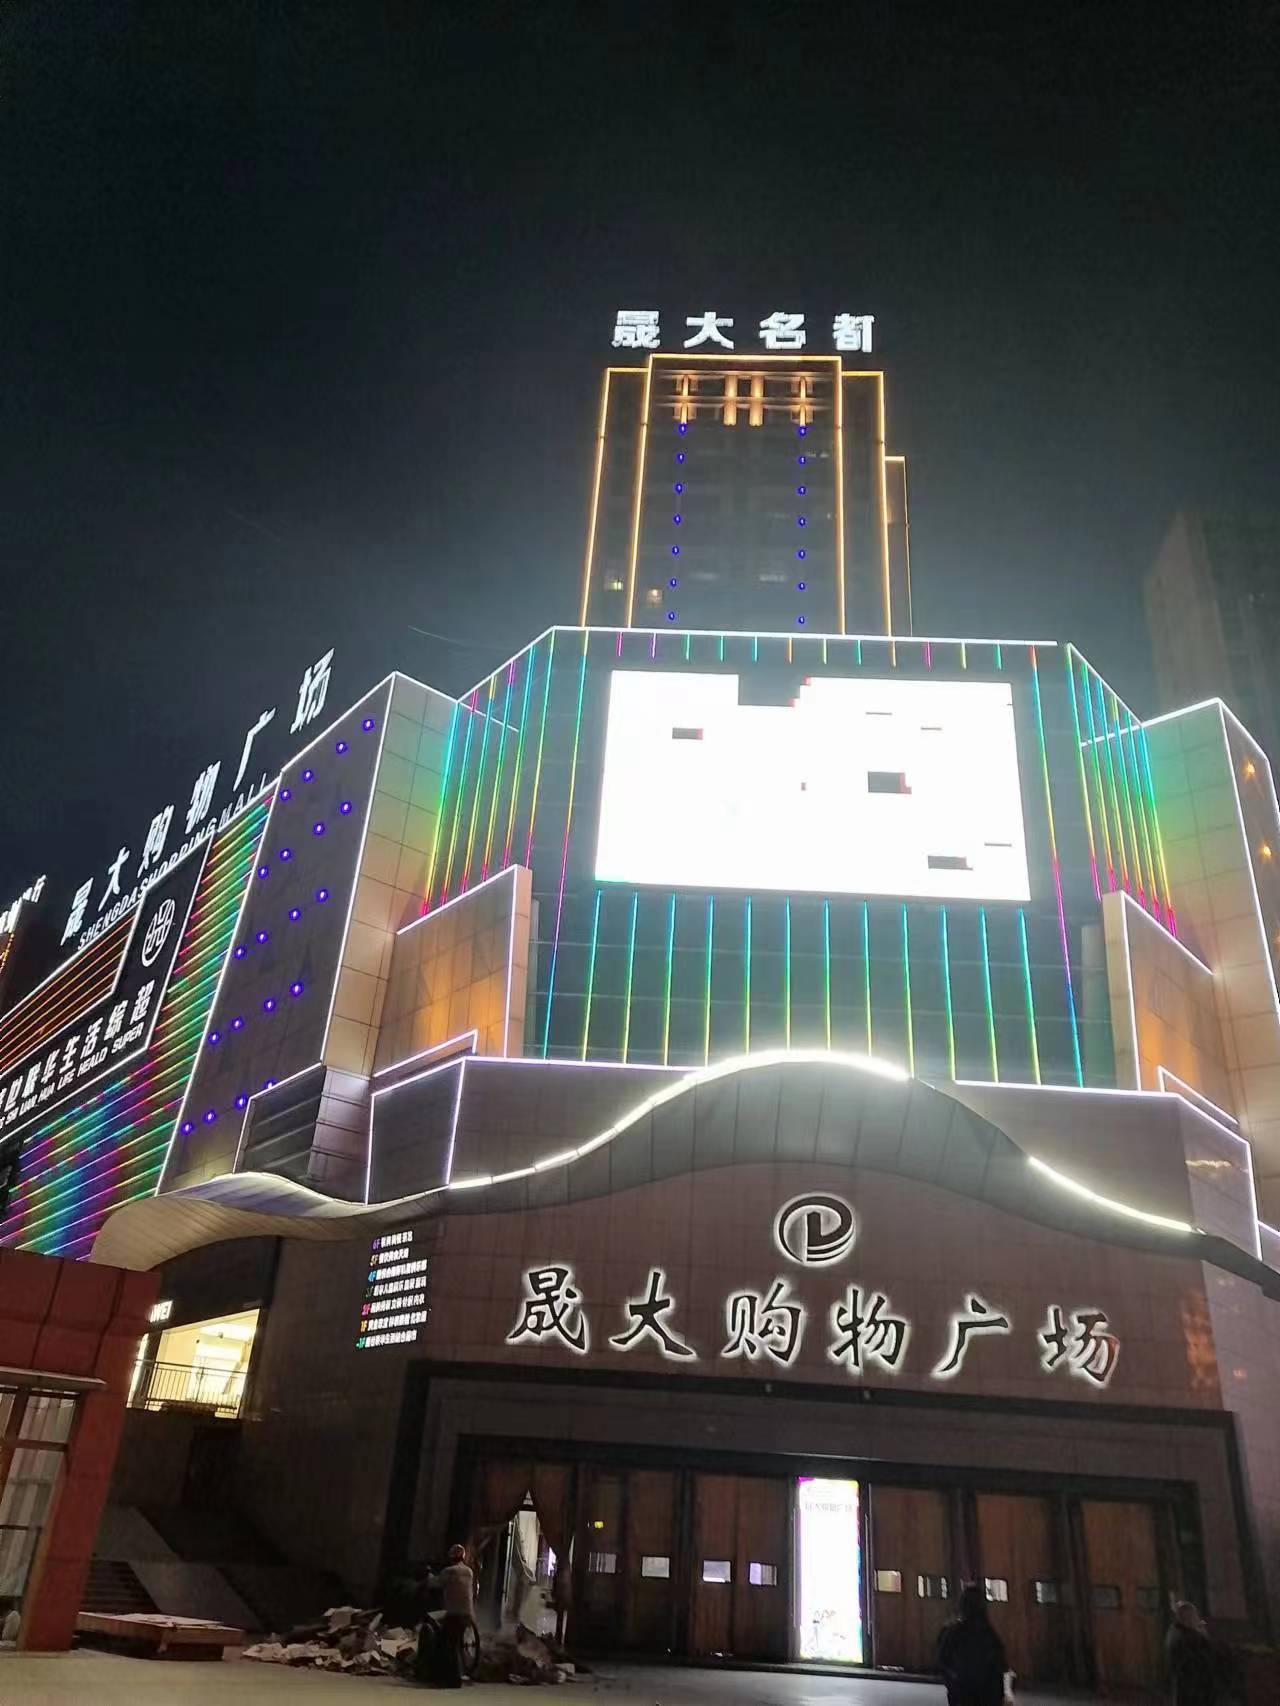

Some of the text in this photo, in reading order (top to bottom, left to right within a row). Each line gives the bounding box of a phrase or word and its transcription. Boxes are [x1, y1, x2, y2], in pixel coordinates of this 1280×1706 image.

[611, 310, 875, 353] 晟大名都
[60, 648, 335, 946] 晟大购物广场
[111, 1022, 144, 1053] SUPER
[505, 1266, 1121, 1388] 晟大购物广场
